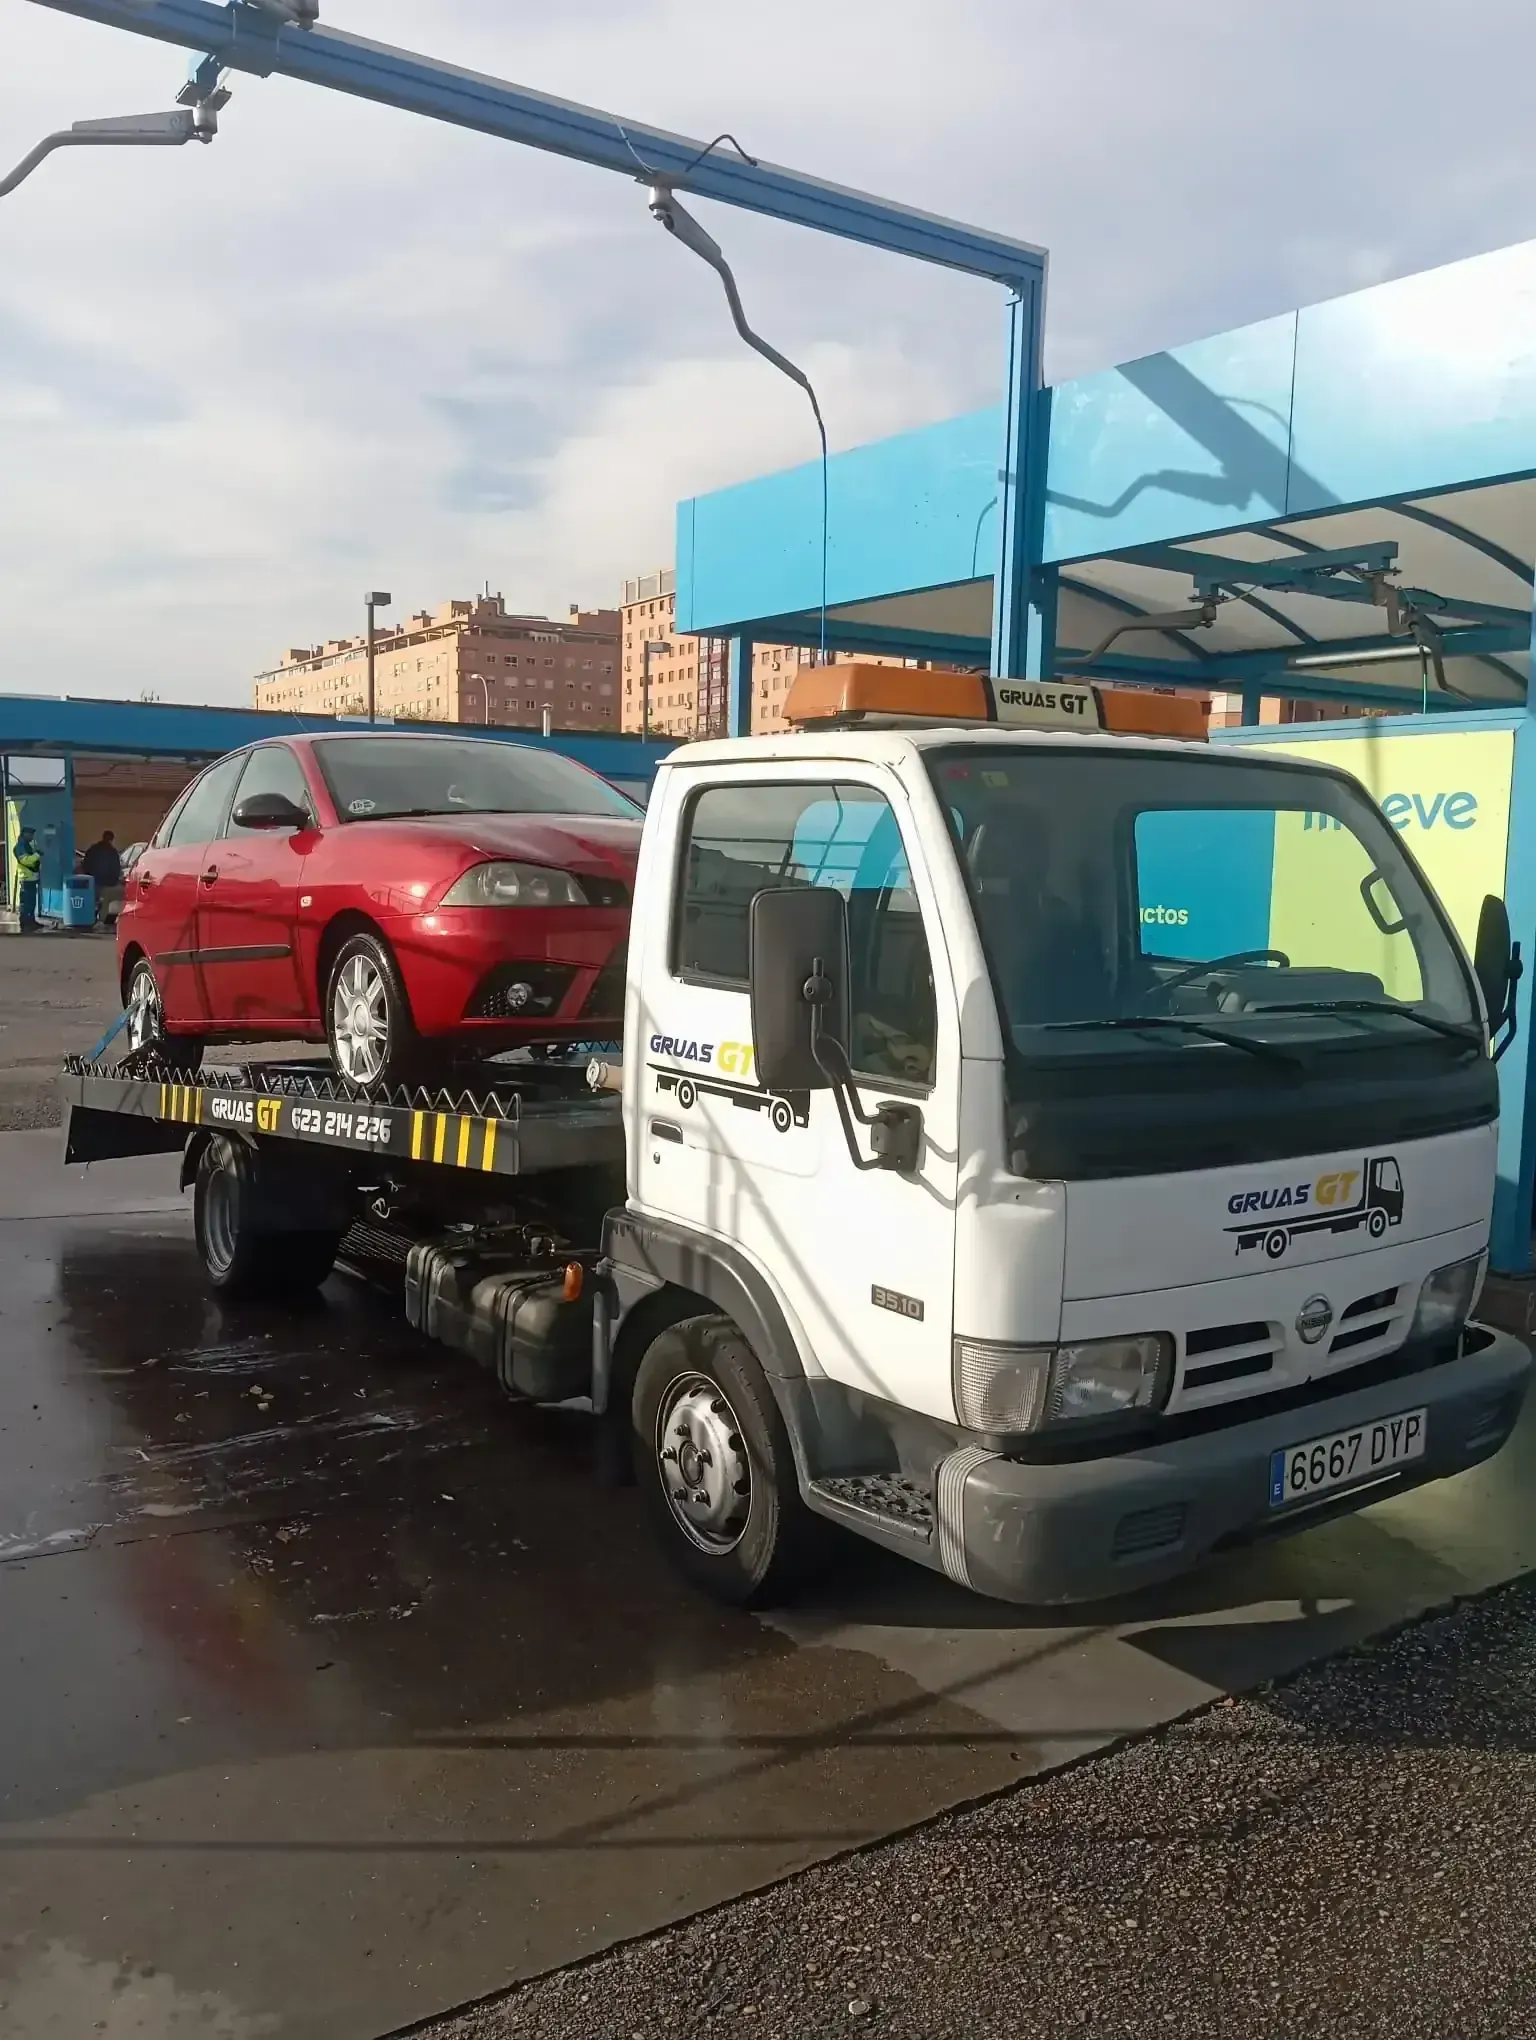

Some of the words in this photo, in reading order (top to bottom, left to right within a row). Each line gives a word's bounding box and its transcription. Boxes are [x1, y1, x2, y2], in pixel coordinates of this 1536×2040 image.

[999, 689, 1057, 709] GRUAS
[1060, 693, 1088, 715] GT
[650, 1034, 714, 1063] GRUAS
[717, 1041, 755, 1076] GT
[211, 1097, 254, 1124] GRUAS
[257, 1099, 282, 1131] GT
[291, 1107, 321, 1133] 623
[325, 1111, 352, 1138] 214
[355, 1115, 392, 1144] 226
[1227, 1183, 1312, 1215] GRUAS
[1315, 1170, 1360, 1206] GT
[1273, 1482, 1282, 1496] E
[1290, 1432, 1362, 1491] 6667
[1371, 1415, 1421, 1466] DYP
